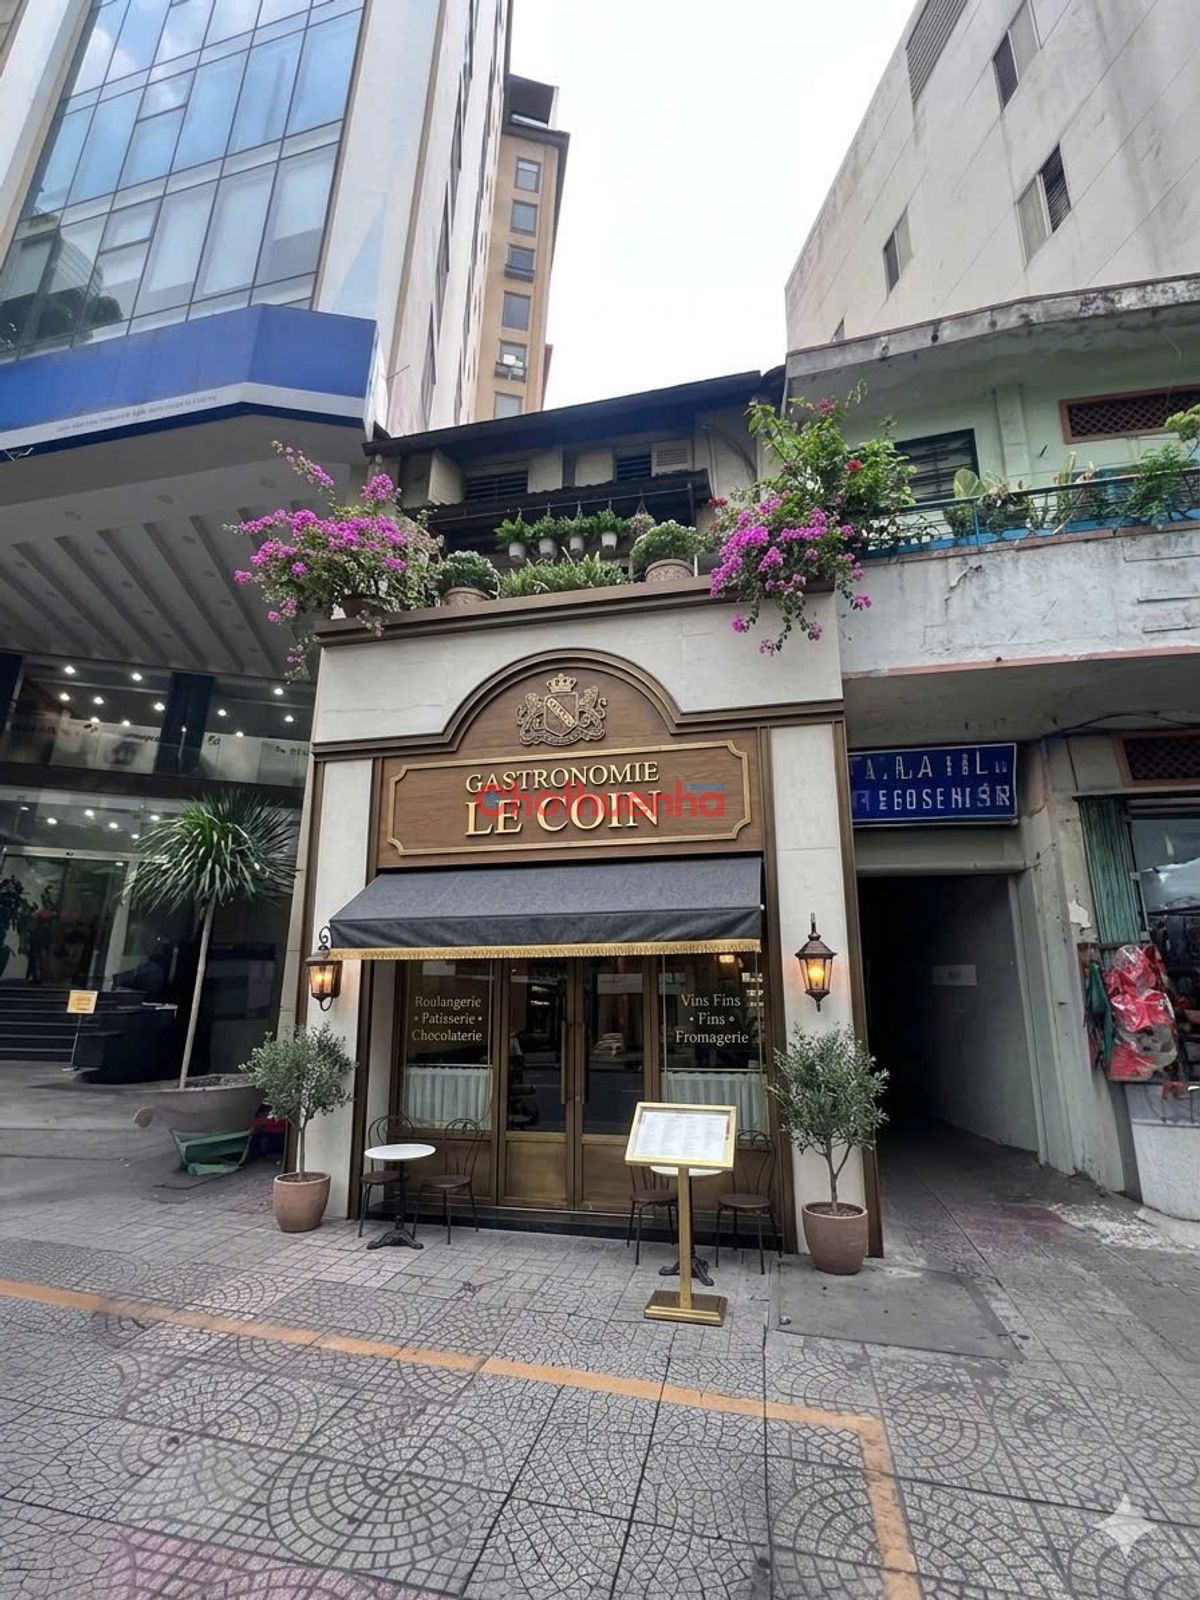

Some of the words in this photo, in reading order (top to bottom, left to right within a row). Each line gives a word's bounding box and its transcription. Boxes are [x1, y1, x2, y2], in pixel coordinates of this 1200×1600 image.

[465, 761, 660, 794] GASTRONOMIE
[465, 799, 523, 837] LE
[537, 789, 662, 833] COIN
[415, 995, 482, 1011] Roulangerie
[681, 993, 710, 1007] Vins
[713, 993, 741, 1007] Fins
[421, 1012, 476, 1025] Patisserie
[698, 1012, 726, 1025] Fins
[676, 1030, 749, 1047] Fromagerie
